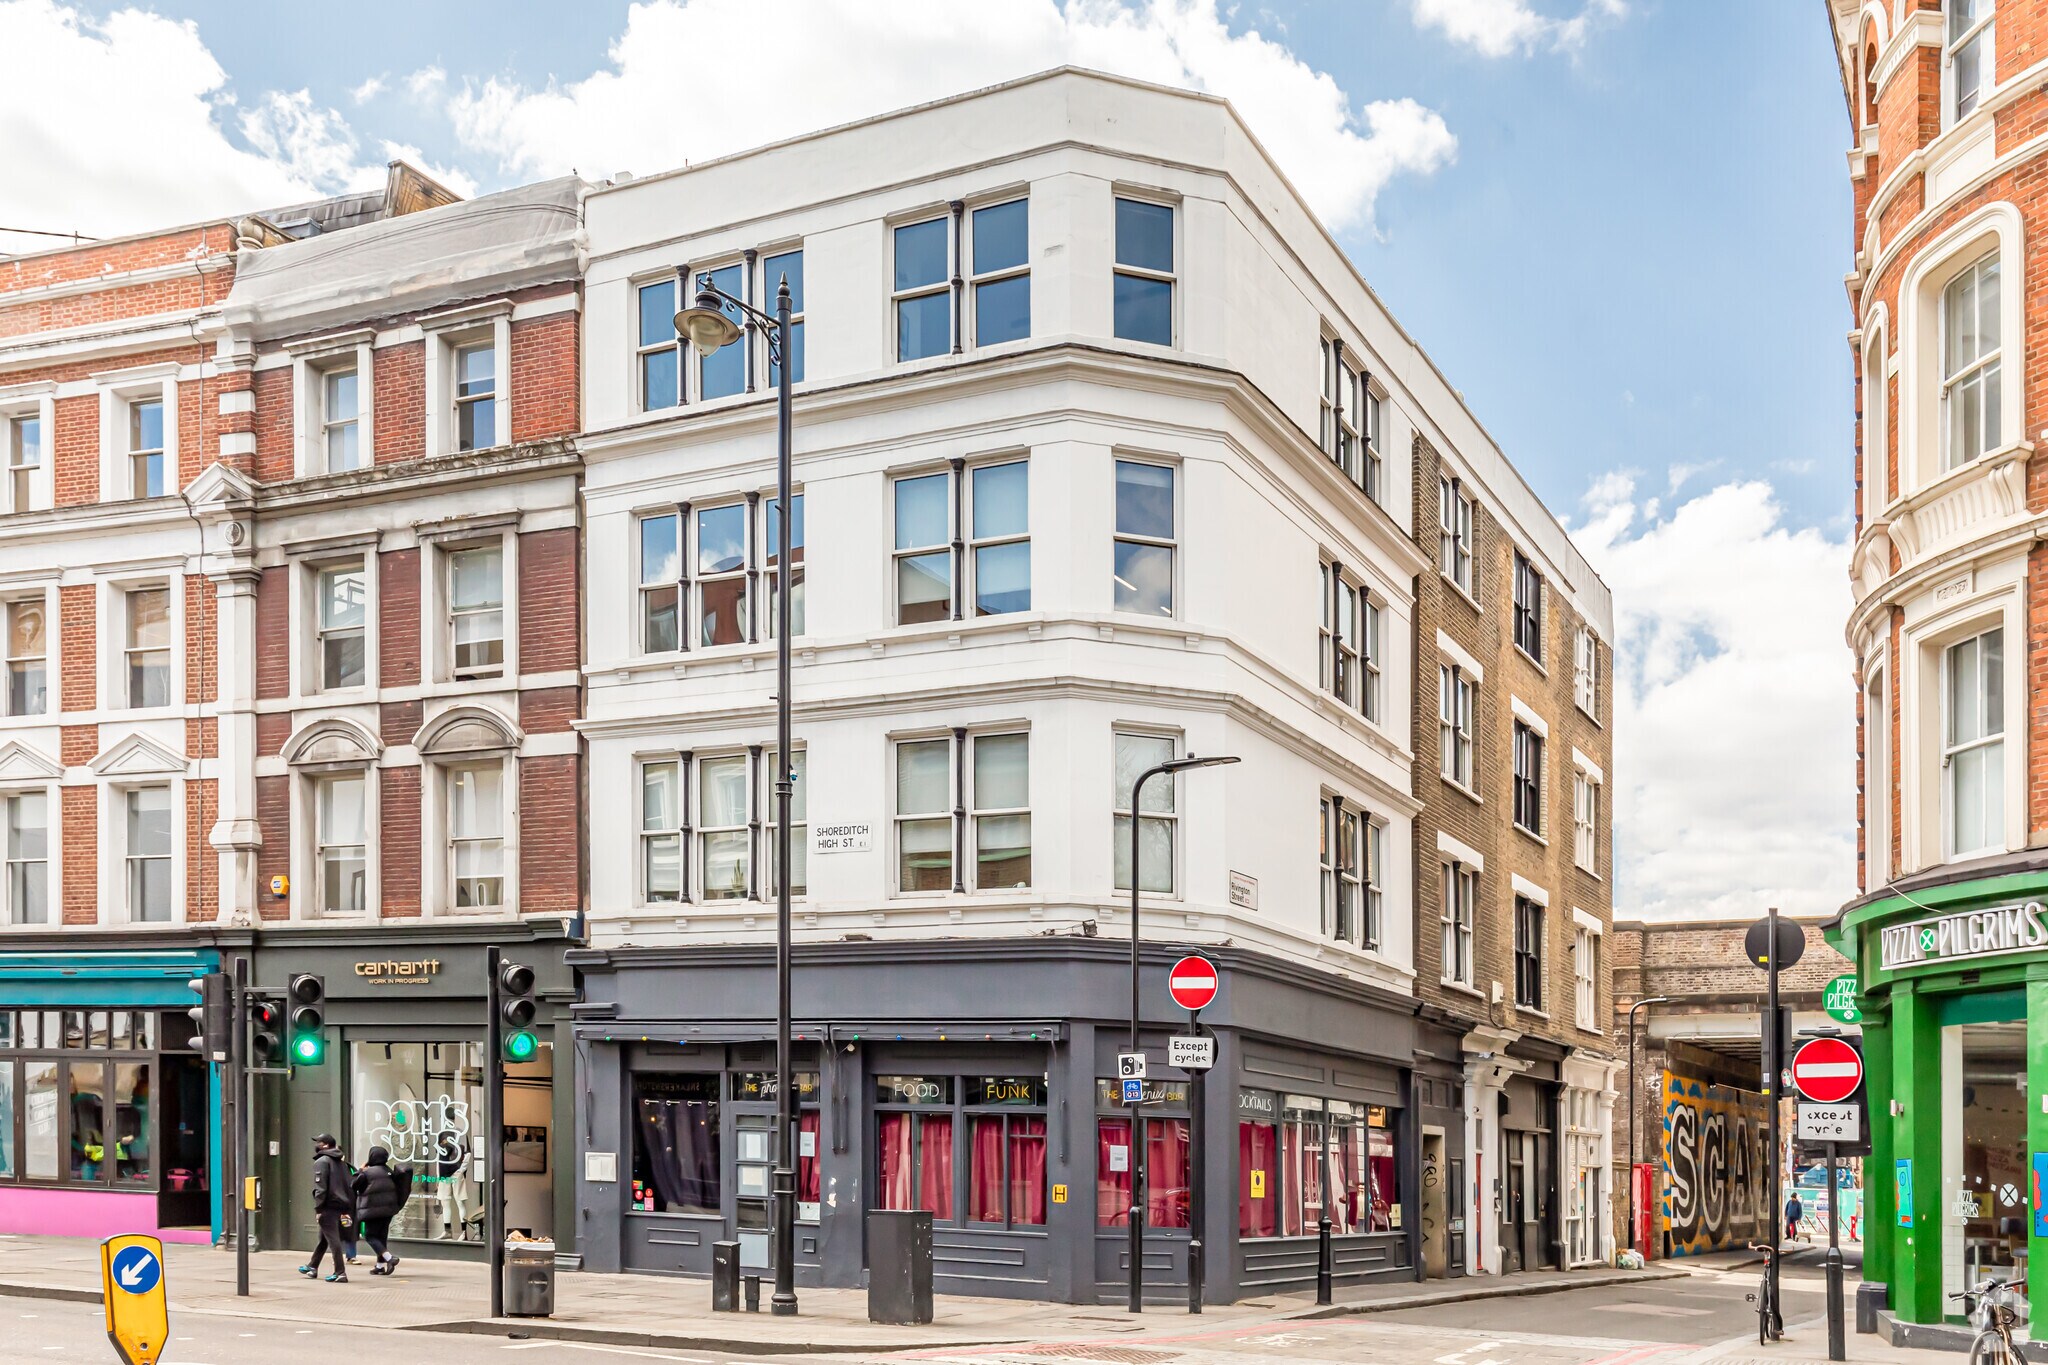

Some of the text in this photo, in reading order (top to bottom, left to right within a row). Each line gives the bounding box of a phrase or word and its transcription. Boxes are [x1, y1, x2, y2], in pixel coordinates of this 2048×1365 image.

[816, 825, 869, 837] SHOREDITCH
[818, 839, 839, 848] HIGH
[1881, 902, 2044, 966] PIZZA PILGRIMS
[355, 959, 440, 976] carhartt
[1837, 979, 1857, 994] PIZZ
[1827, 992, 1857, 1008] PILGR
[1173, 1040, 1208, 1053] Except
[745, 1082, 758, 1092] THE
[894, 1083, 940, 1098] FOOD
[987, 1084, 1031, 1099] FUNK
[1103, 1089, 1119, 1099] THE
[365, 1094, 469, 1135] DOM'S
[370, 1127, 462, 1164] SUBS
[1054, 1186, 1066, 1202] H
